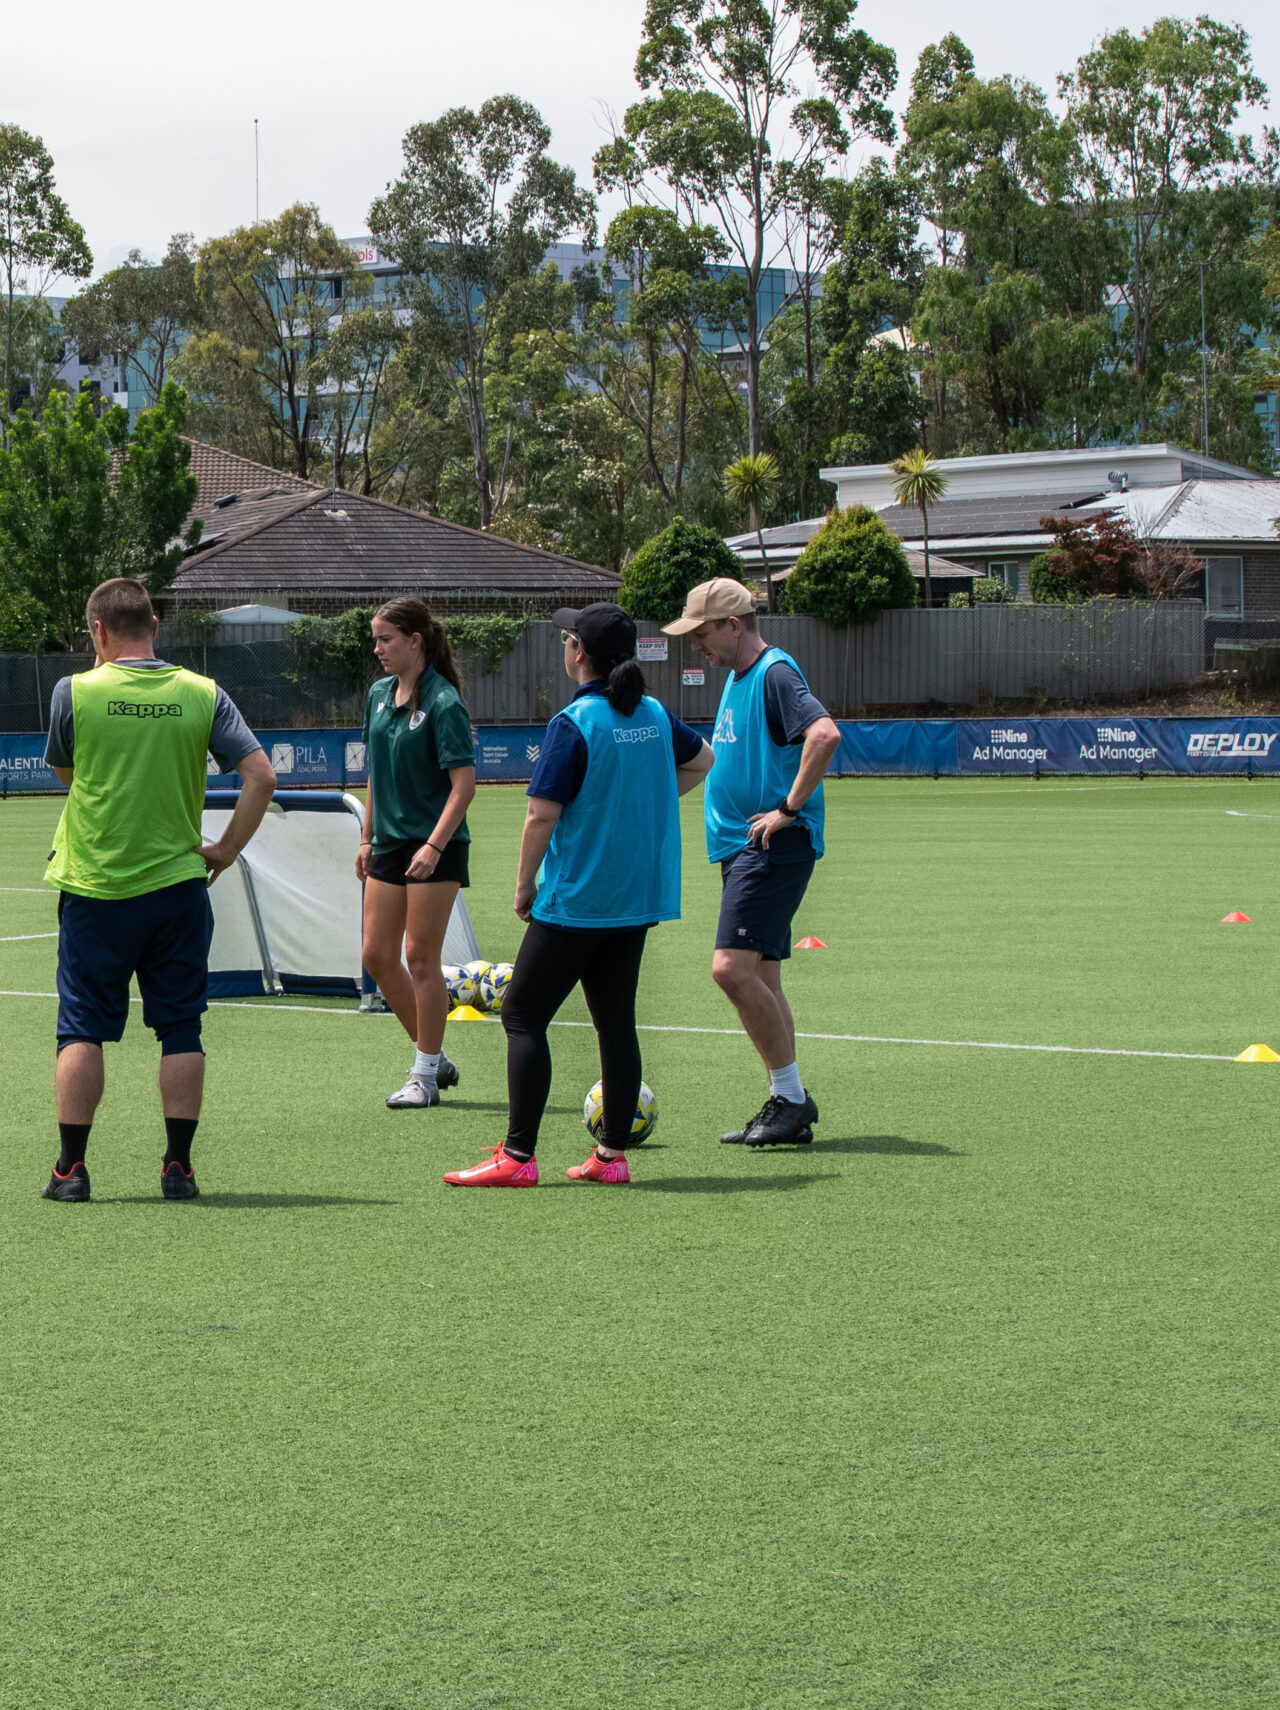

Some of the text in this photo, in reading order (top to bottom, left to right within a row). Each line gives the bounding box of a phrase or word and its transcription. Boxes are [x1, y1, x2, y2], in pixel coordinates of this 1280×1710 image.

[108, 701, 182, 718] Kappa
[613, 725, 660, 743] Kappa
[1002, 729, 1028, 743] Nine
[1108, 727, 1137, 743] Nine
[1187, 732, 1278, 751] DEPLOY
[296, 746, 327, 764] PILA
[973, 745, 1048, 764] Ad Manager
[1080, 744, 1158, 763] Ad Manager
[31, 770, 53, 780] PARK
